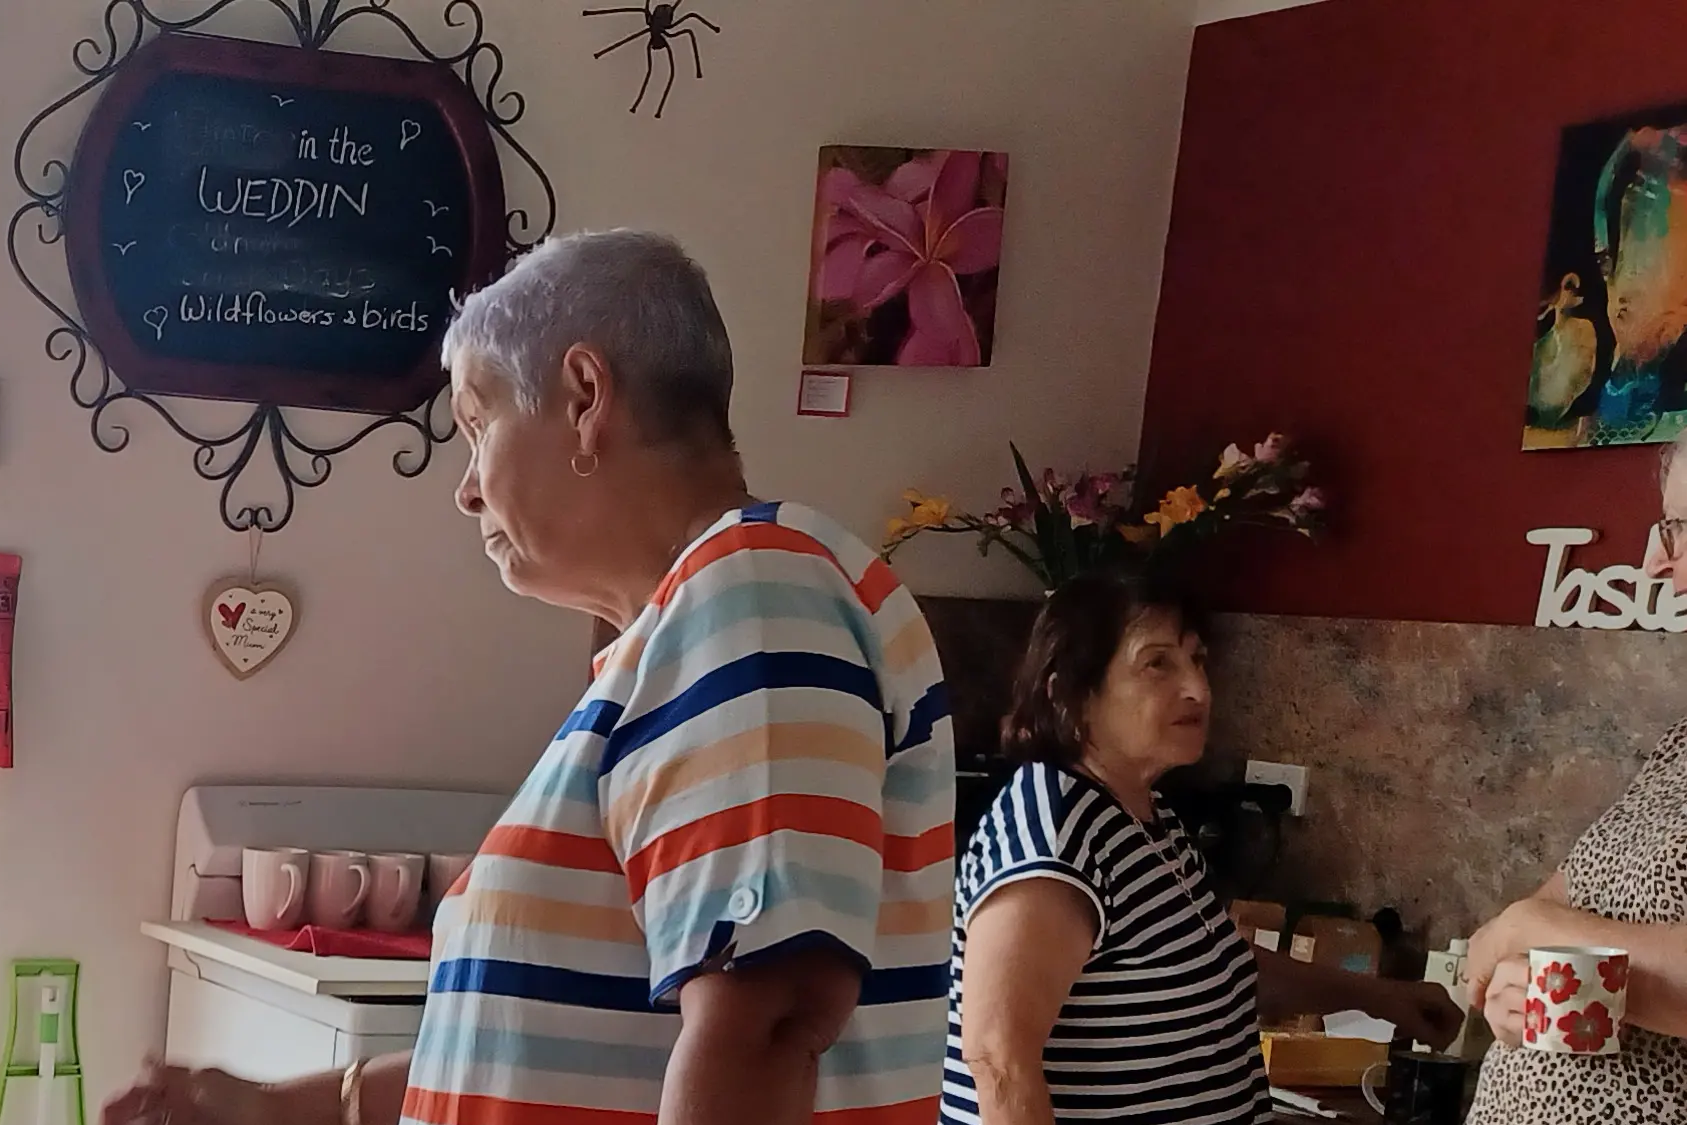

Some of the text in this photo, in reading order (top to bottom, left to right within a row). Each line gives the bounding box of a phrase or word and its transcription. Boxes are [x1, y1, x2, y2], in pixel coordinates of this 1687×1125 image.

[298, 129, 318, 160] in
[328, 126, 375, 166] the
[198, 165, 368, 228] WEDDIN
[180, 290, 334, 326] Wildflowers
[362, 300, 429, 332] birds
[232, 634, 264, 649] Mum
[242, 618, 279, 635] Special
